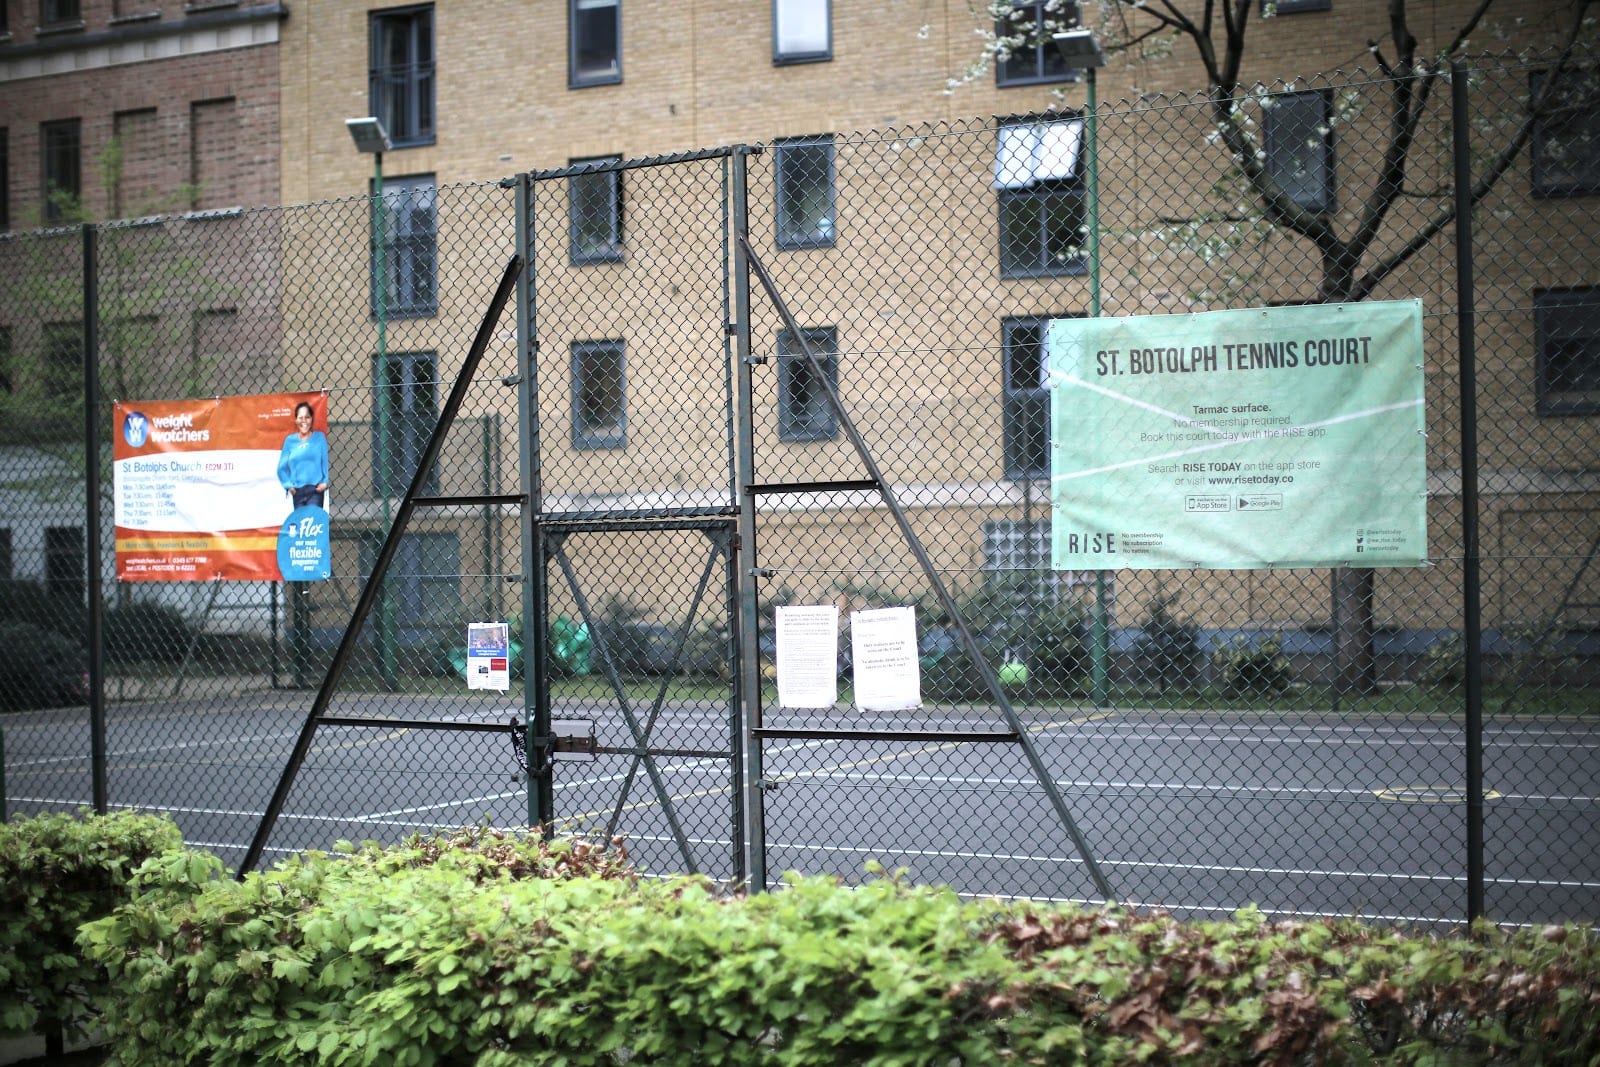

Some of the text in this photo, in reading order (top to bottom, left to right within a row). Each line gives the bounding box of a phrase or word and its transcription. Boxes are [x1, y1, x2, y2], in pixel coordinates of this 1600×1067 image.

[1097, 337, 1371, 376] ST. BOTOLPH TENNIS COURT
[1193, 404, 1271, 414] Tarmac surface.
[152, 413, 193, 429] weight
[1174, 419, 1187, 428] No
[1189, 418, 1248, 428] membership
[151, 428, 210, 442] watchers
[1141, 433, 1164, 442] Book
[1166, 432, 1183, 441] this
[1186, 432, 1210, 442] court
[1212, 431, 1239, 442] today
[1242, 430, 1262, 438] with
[1264, 429, 1279, 438] the
[1282, 428, 1304, 437] RISE
[123, 462, 131, 472] St
[134, 462, 167, 473] Botolphs
[171, 461, 201, 472] Church
[1148, 464, 1180, 473] Search
[1183, 464, 1205, 472] RISE
[1208, 463, 1241, 472] TODAY
[1258, 462, 1273, 471] the
[1276, 463, 1295, 472] app
[1297, 461, 1320, 470] store
[1175, 475, 1294, 486] or visit www.risetoday.co
[300, 516, 324, 538] Flex
[1069, 533, 1116, 553] RISE
[290, 547, 322, 558] flexible
